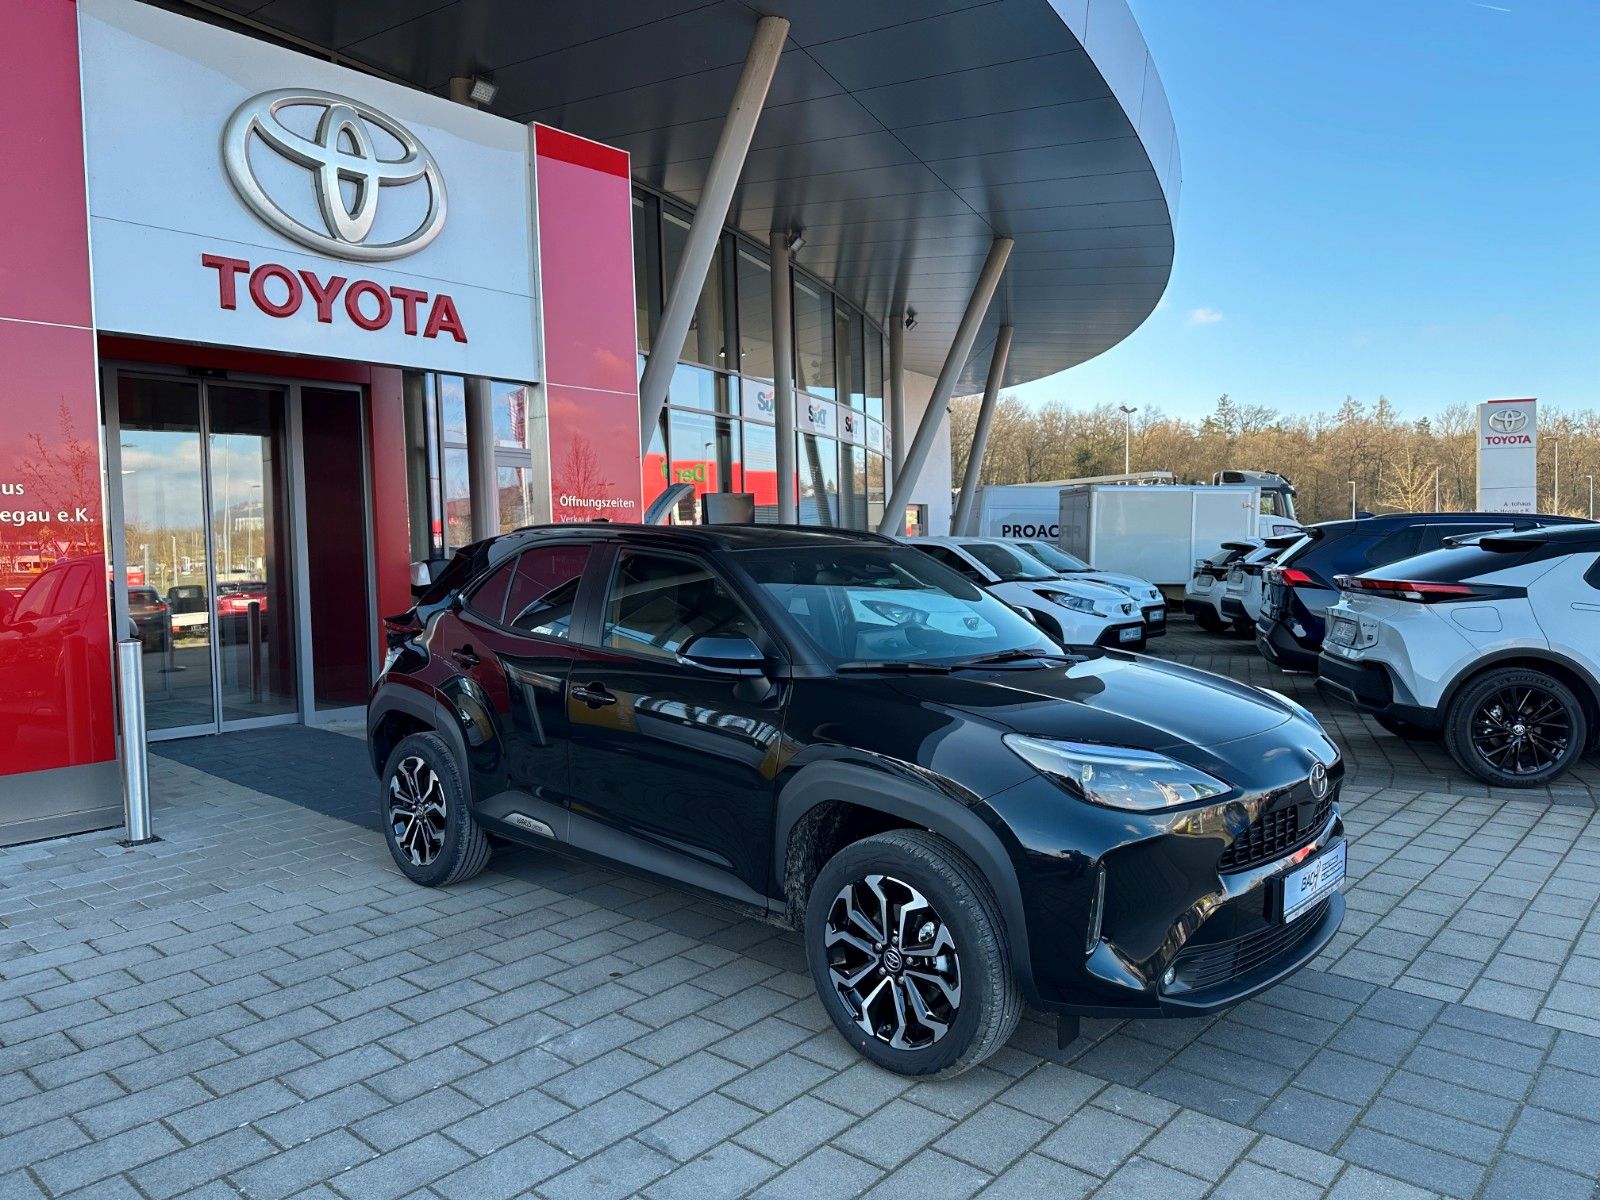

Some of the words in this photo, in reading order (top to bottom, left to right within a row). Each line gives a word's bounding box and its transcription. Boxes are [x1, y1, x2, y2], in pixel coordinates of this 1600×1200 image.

[202, 253, 468, 344] TOYOTA
[1485, 435, 1532, 445] TOYOTA
[0, 483, 25, 495] us
[560, 494, 635, 510] Öffnungszeiten
[0, 510, 50, 527] egau
[57, 507, 94, 522] e.K.
